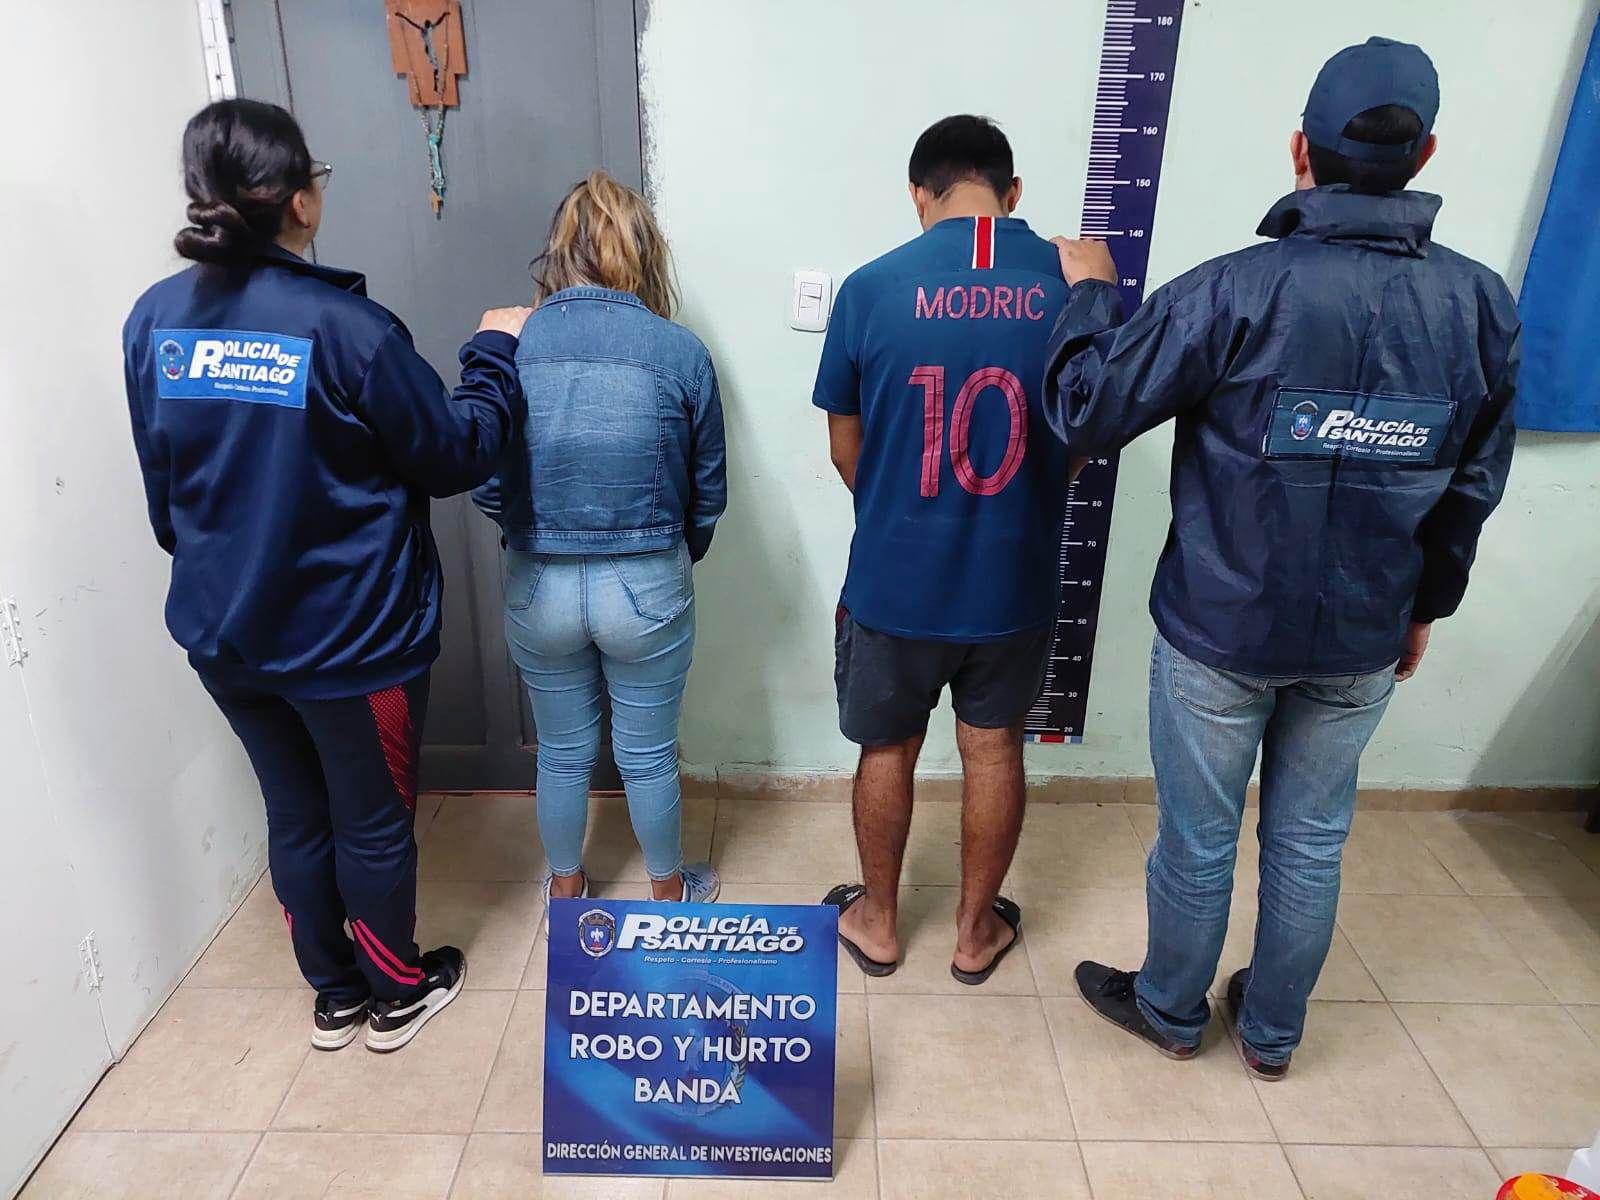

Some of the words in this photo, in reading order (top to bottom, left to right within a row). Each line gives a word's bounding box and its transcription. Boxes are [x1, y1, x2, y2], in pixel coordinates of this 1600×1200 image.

[1157, 16, 1173, 26] 180
[1150, 72, 1165, 81] 170
[1142, 126, 1158, 135] 160
[1135, 178, 1151, 187] 150
[1129, 229, 1144, 238] 140
[1122, 278, 1137, 287] 130
[915, 283, 1046, 321] MODRIĆ
[277, 353, 302, 367] DE
[207, 363, 295, 384] SANTIAGO
[1317, 409, 1415, 438] POLICÍA
[1414, 427, 1431, 435] DE
[908, 365, 1028, 498] 10
[1328, 427, 1428, 447] SANTIAGO
[1097, 457, 1108, 466] 90
[1092, 499, 1102, 507] 80
[1087, 540, 1097, 548] 70
[1081, 579, 1091, 587] 60
[1077, 617, 1087, 625] 50
[1072, 654, 1082, 662] 40
[617, 914, 769, 949] POLICÍA
[777, 926, 798, 935] DE
[641, 934, 804, 952] SANTIAGO
[569, 990, 816, 1020] DEPARTAMENTO
[570, 1033, 662, 1060] ROBO
[673, 1036, 693, 1061] Y
[703, 1037, 811, 1062] HURTO
[634, 1077, 741, 1104] BANDA
[547, 1140, 621, 1159] DIRECCIÓN
[624, 1145, 687, 1161] GENERAL
[690, 1147, 707, 1161] DE
[711, 1146, 832, 1163] INVESTIGACIONES
